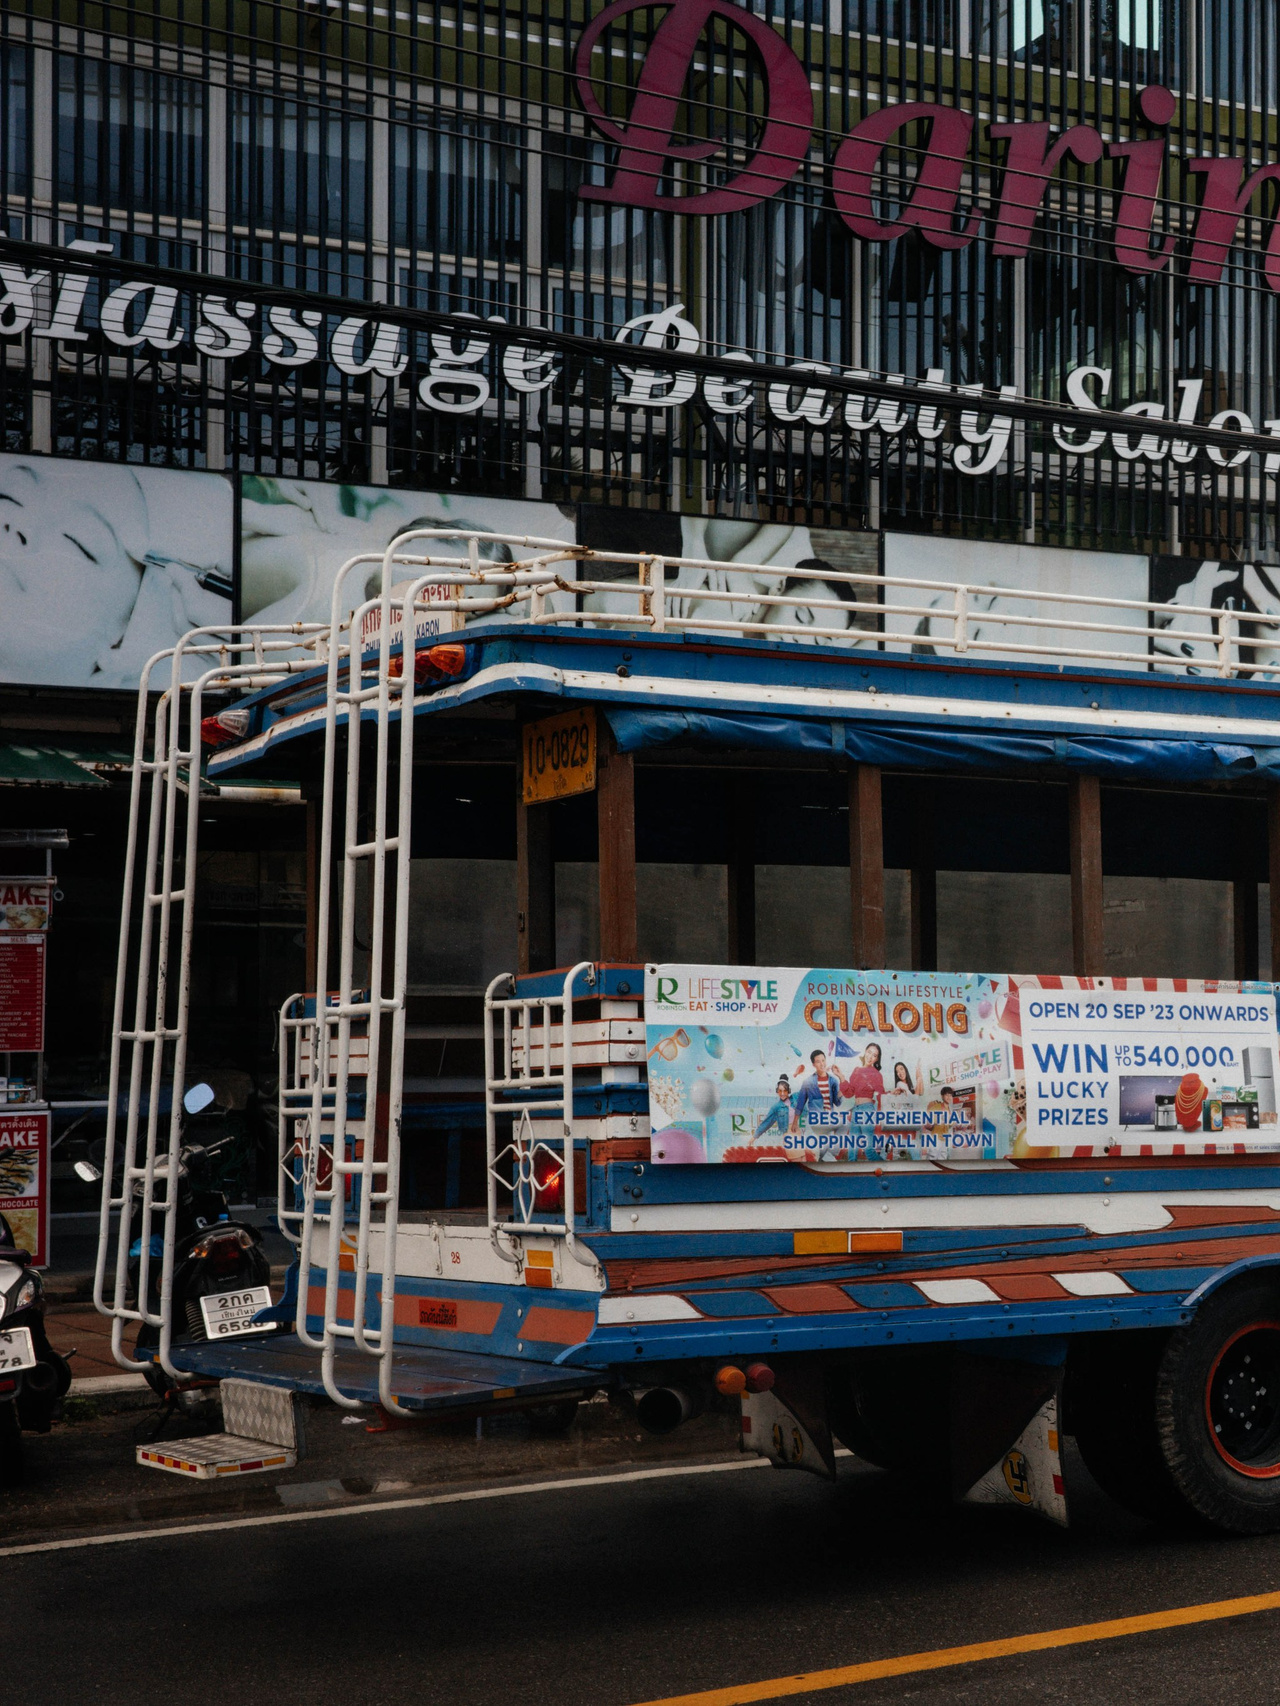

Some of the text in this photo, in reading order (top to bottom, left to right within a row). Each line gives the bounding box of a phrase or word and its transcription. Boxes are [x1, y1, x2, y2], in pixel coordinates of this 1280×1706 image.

[613, 303, 1018, 475] Beauty
[416, 618, 440, 638] KARON
[528, 723, 589, 778] 10-0829
[0, 886, 46, 905] AKE
[689, 979, 778, 1000] LIFESTYLE
[808, 982, 963, 999] ROBINSON LIFESTYLE
[689, 1001, 708, 1011] EAT
[716, 1001, 746, 1012] SHOP
[752, 1002, 778, 1013] PLAY
[803, 999, 970, 1034] CHALONG
[1029, 1001, 1079, 1019] OPEN
[1085, 1003, 1108, 1019] 20
[1113, 1003, 1146, 1020] SEP
[1179, 1005, 1269, 1022] ONWARDS
[1031, 1043, 1109, 1074] WIN
[1115, 1045, 1130, 1056] UP
[1134, 1045, 1235, 1070] 540,000
[945, 1048, 1001, 1077] LIFESTYLE
[1115, 1056, 1132, 1067] TO
[946, 1064, 1002, 1084] EAT SHOP PLAY
[1038, 1081, 1109, 1099] LUCKY
[808, 1111, 850, 1125] BEST
[854, 1111, 969, 1126] EXPERIENTIAL
[1038, 1108, 1109, 1126] PRIZES
[783, 1133, 993, 1149] SHOPPING MALL IN TOWN
[0, 1200, 38, 1209] HOCOLATE
[450, 1251, 461, 1264] 28
